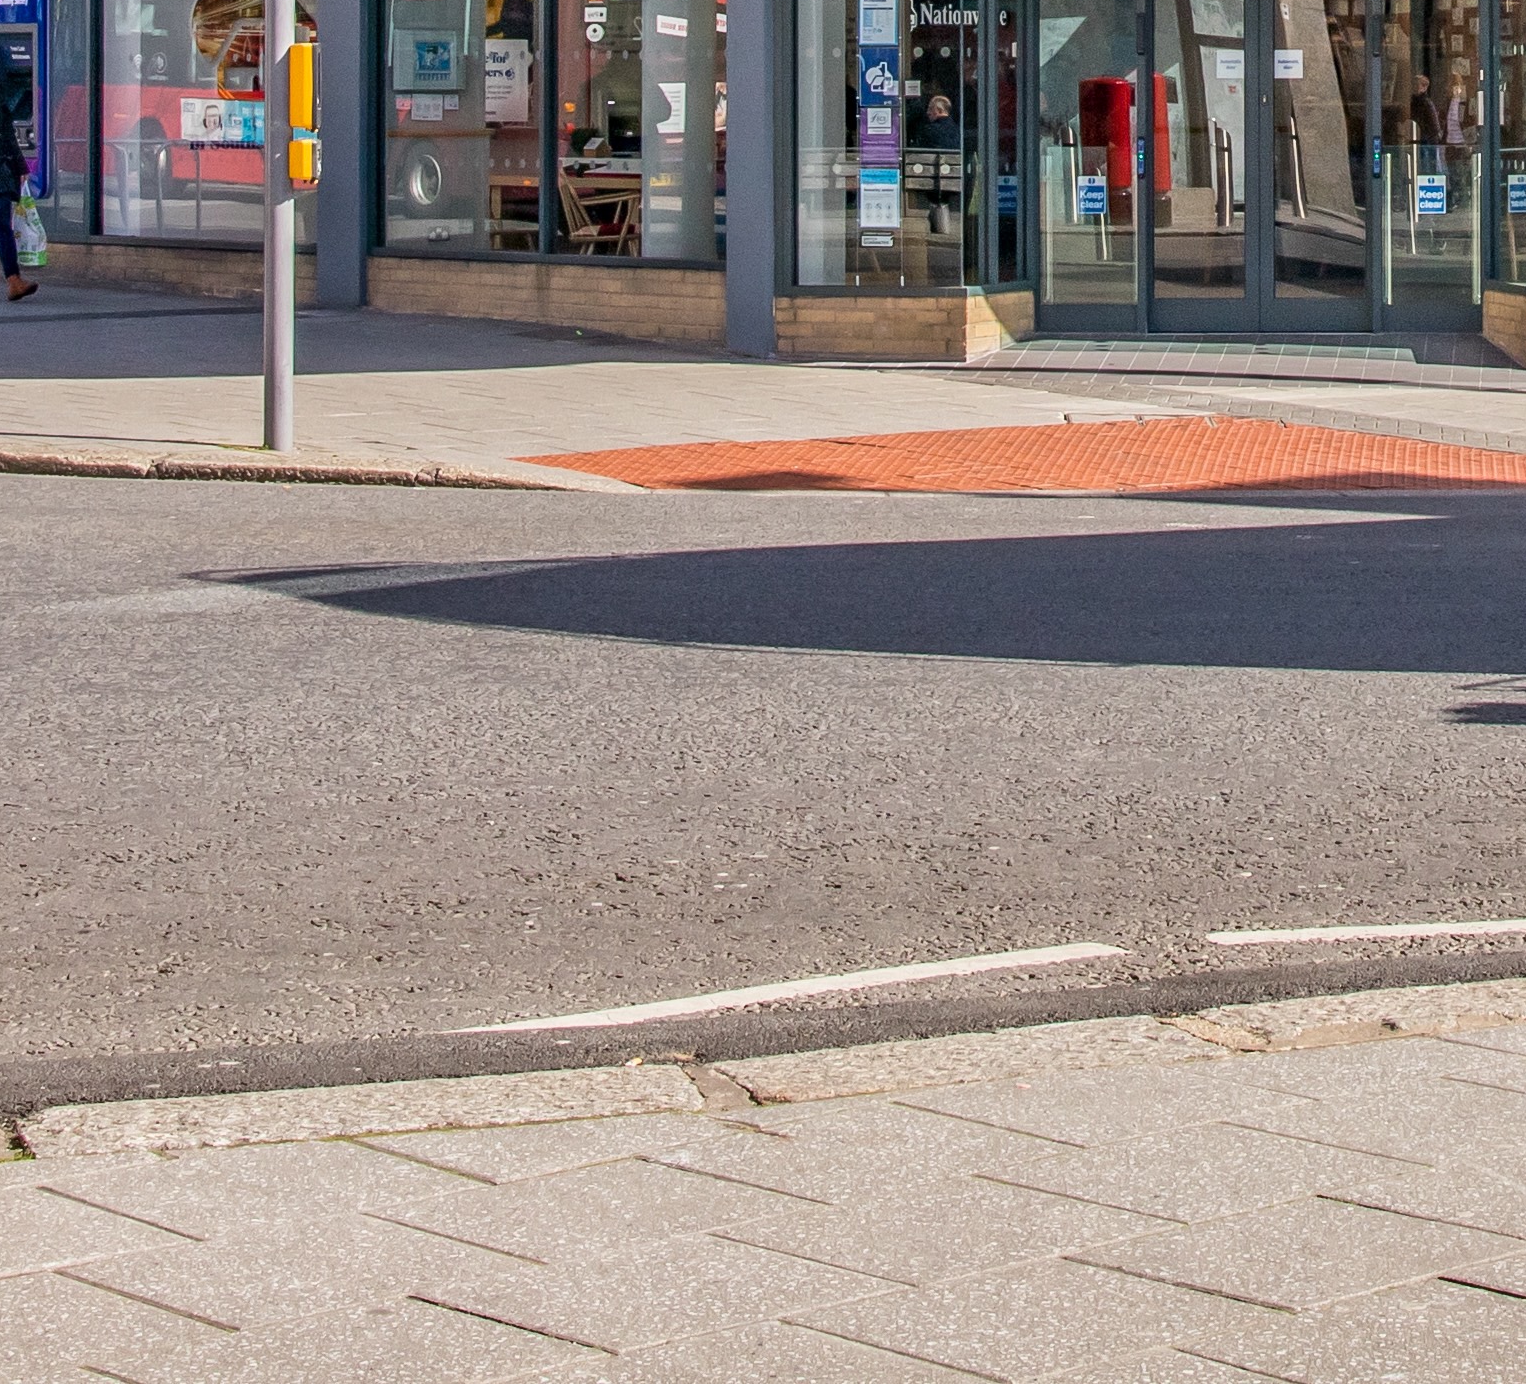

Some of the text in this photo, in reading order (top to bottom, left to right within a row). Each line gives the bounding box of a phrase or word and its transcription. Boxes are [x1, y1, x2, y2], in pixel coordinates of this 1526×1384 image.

[1080, 190, 1104, 201] Keep
[1419, 190, 1443, 201] Keep
[1080, 201, 1103, 209] clear
[1419, 200, 1443, 209] clear
